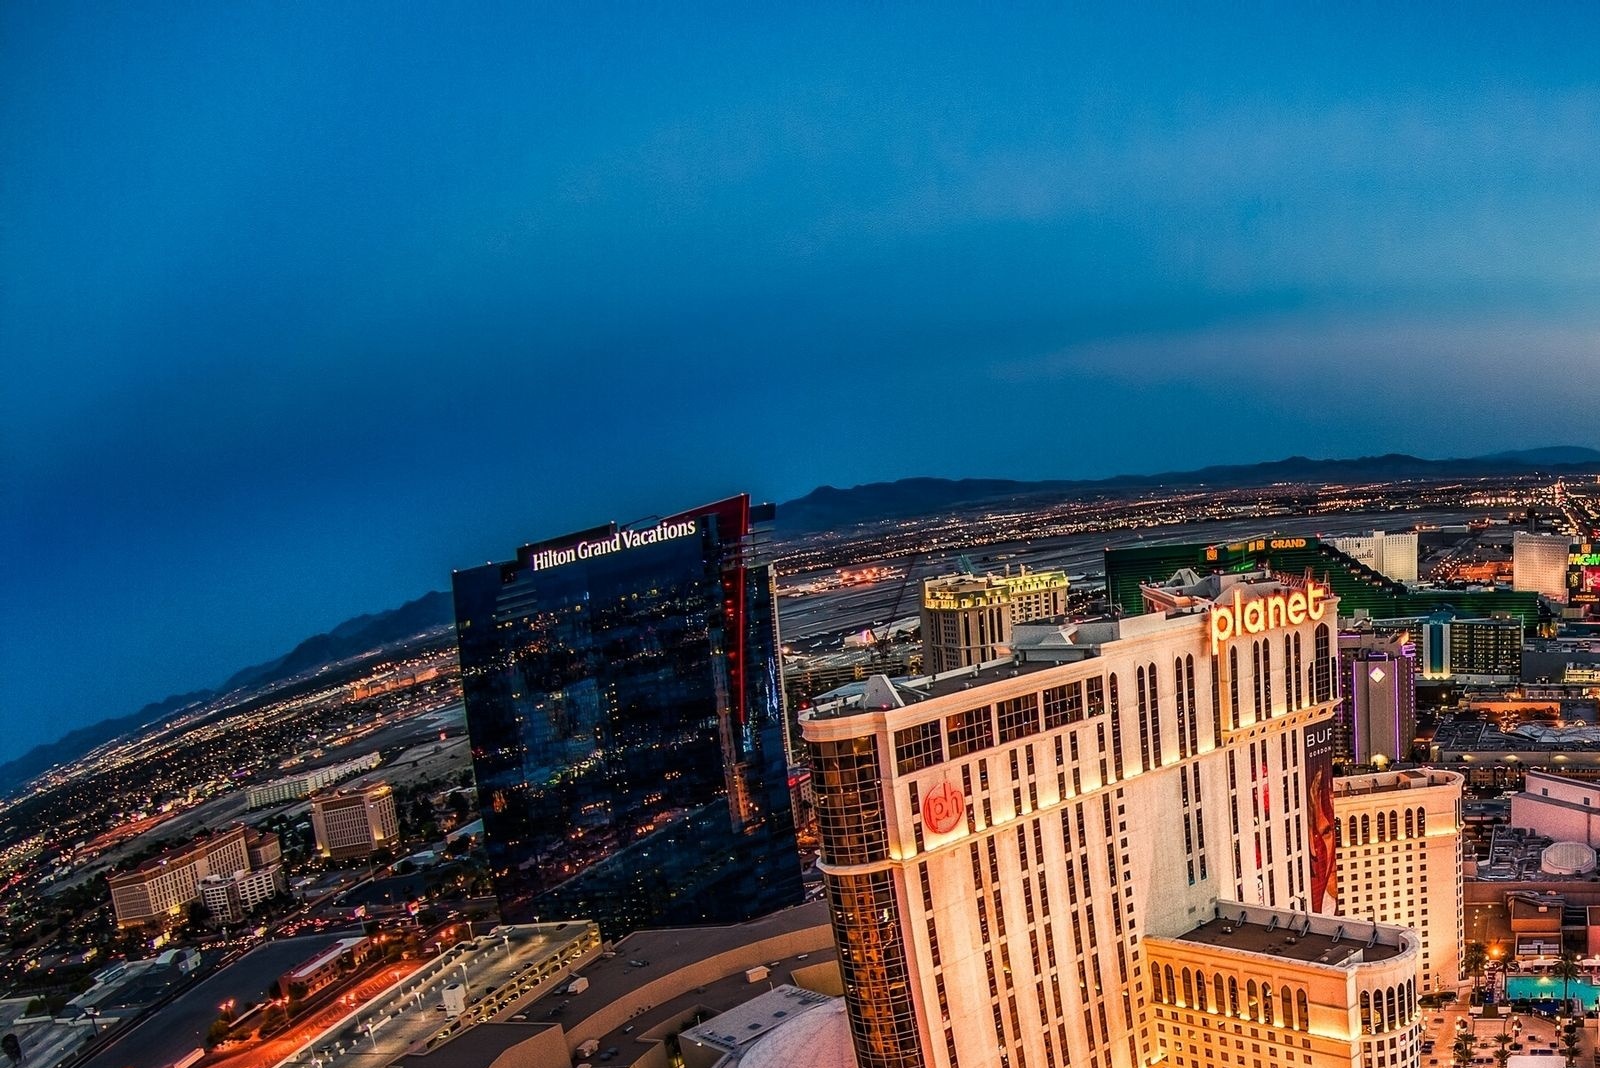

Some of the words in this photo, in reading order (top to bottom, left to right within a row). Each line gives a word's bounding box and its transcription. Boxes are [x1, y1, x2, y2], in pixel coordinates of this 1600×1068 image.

[532, 549, 576, 571] Hilton
[577, 533, 621, 560] Grand
[621, 520, 696, 549] Vacations
[1270, 539, 1307, 549] GRAND
[1211, 580, 1326, 656] planet
[927, 782, 965, 830] ph
